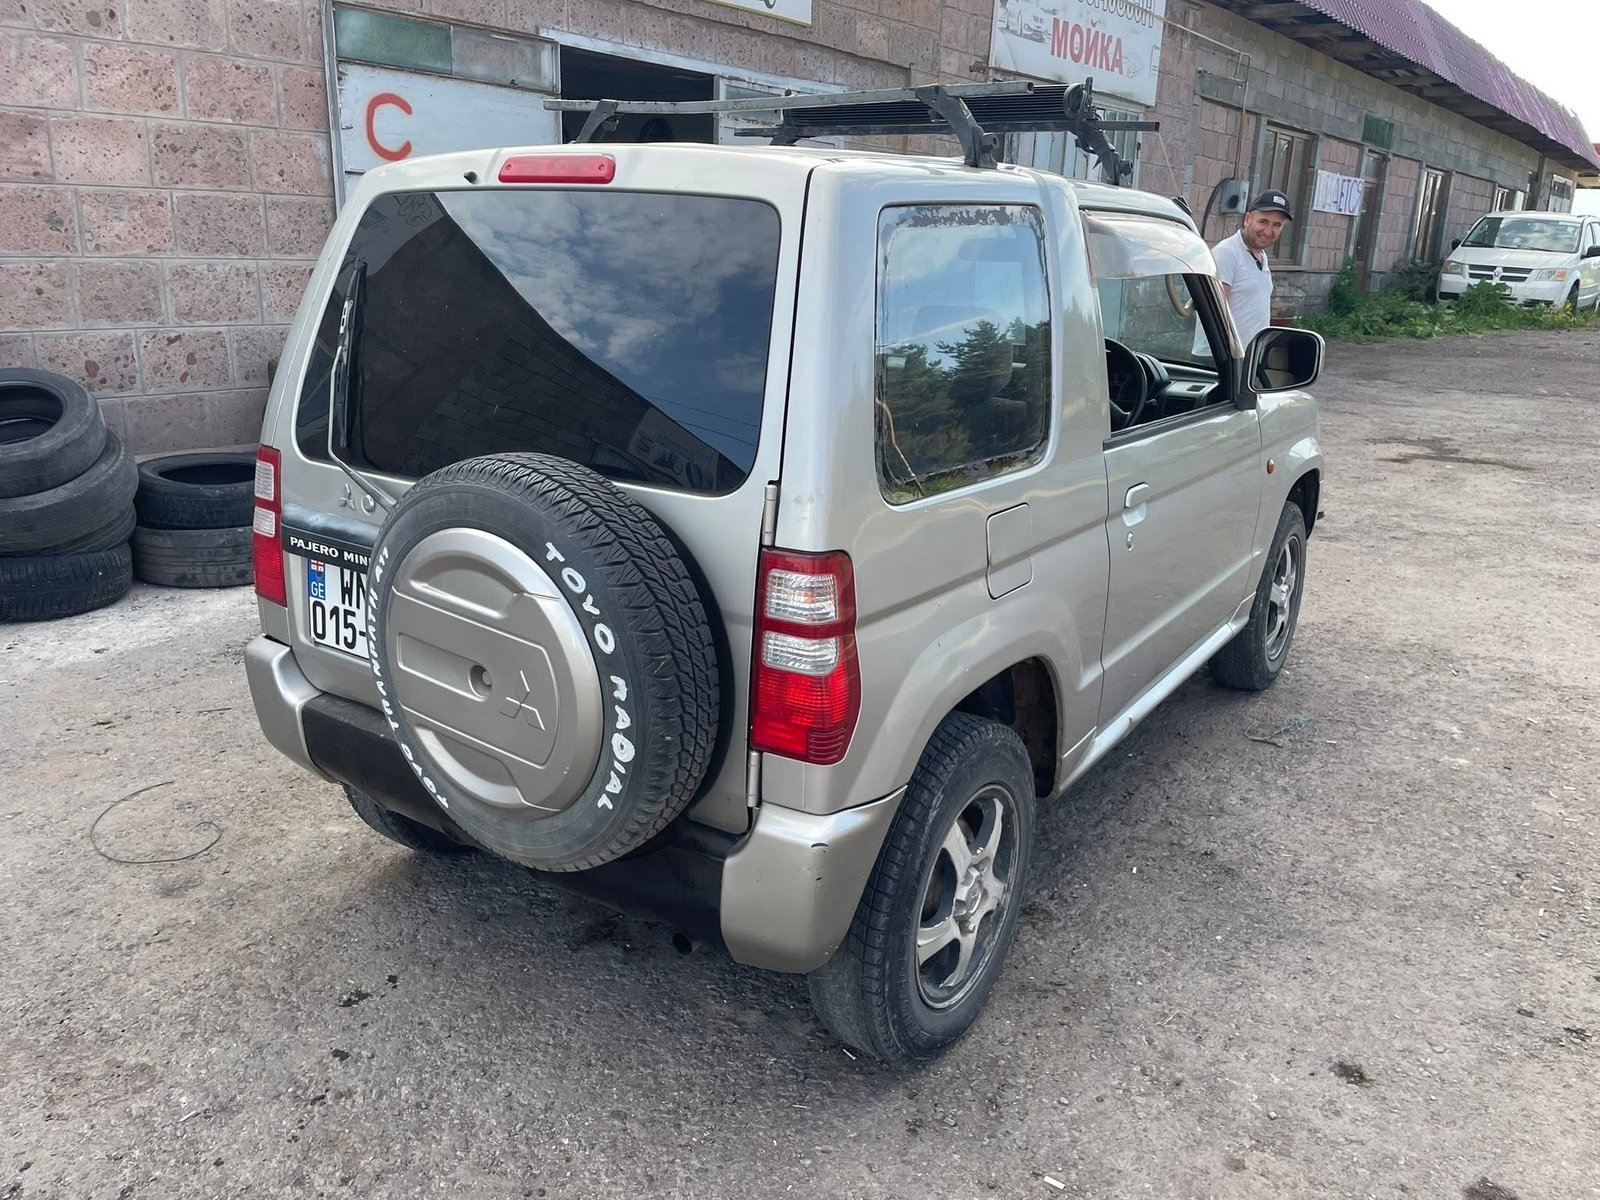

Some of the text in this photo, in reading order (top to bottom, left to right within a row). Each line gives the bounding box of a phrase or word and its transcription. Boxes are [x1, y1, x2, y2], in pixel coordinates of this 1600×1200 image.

[1051, 16, 1124, 75] МОЙКА
[289, 536, 370, 567] PAJERO MIN
[311, 581, 325, 599] GE
[545, 541, 636, 810] TOYO RADIAL
